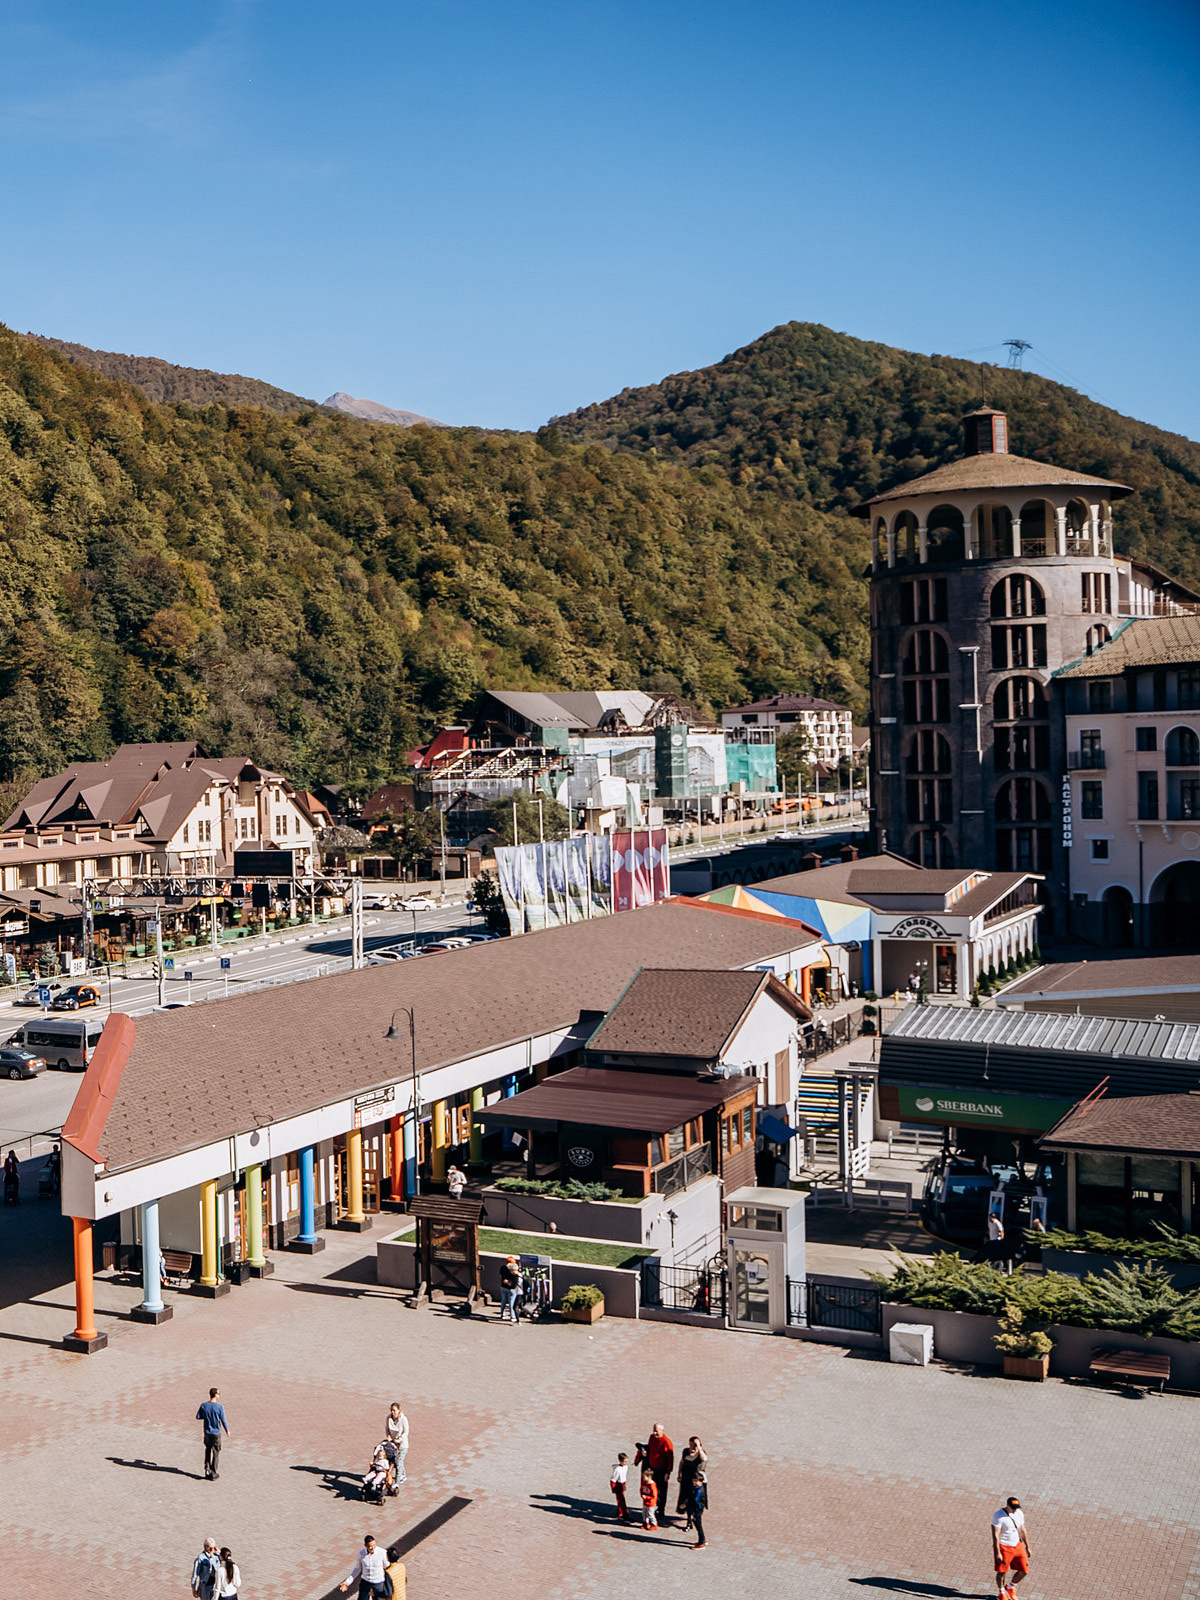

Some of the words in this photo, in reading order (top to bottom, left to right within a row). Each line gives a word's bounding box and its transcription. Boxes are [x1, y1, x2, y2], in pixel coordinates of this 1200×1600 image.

[1062, 774, 1073, 847] ГАСТРОНОМ
[896, 919, 943, 937] СТОЛОВАЯ
[42, 990, 48, 1000] P
[936, 1100, 1003, 1115] SBERBANK
